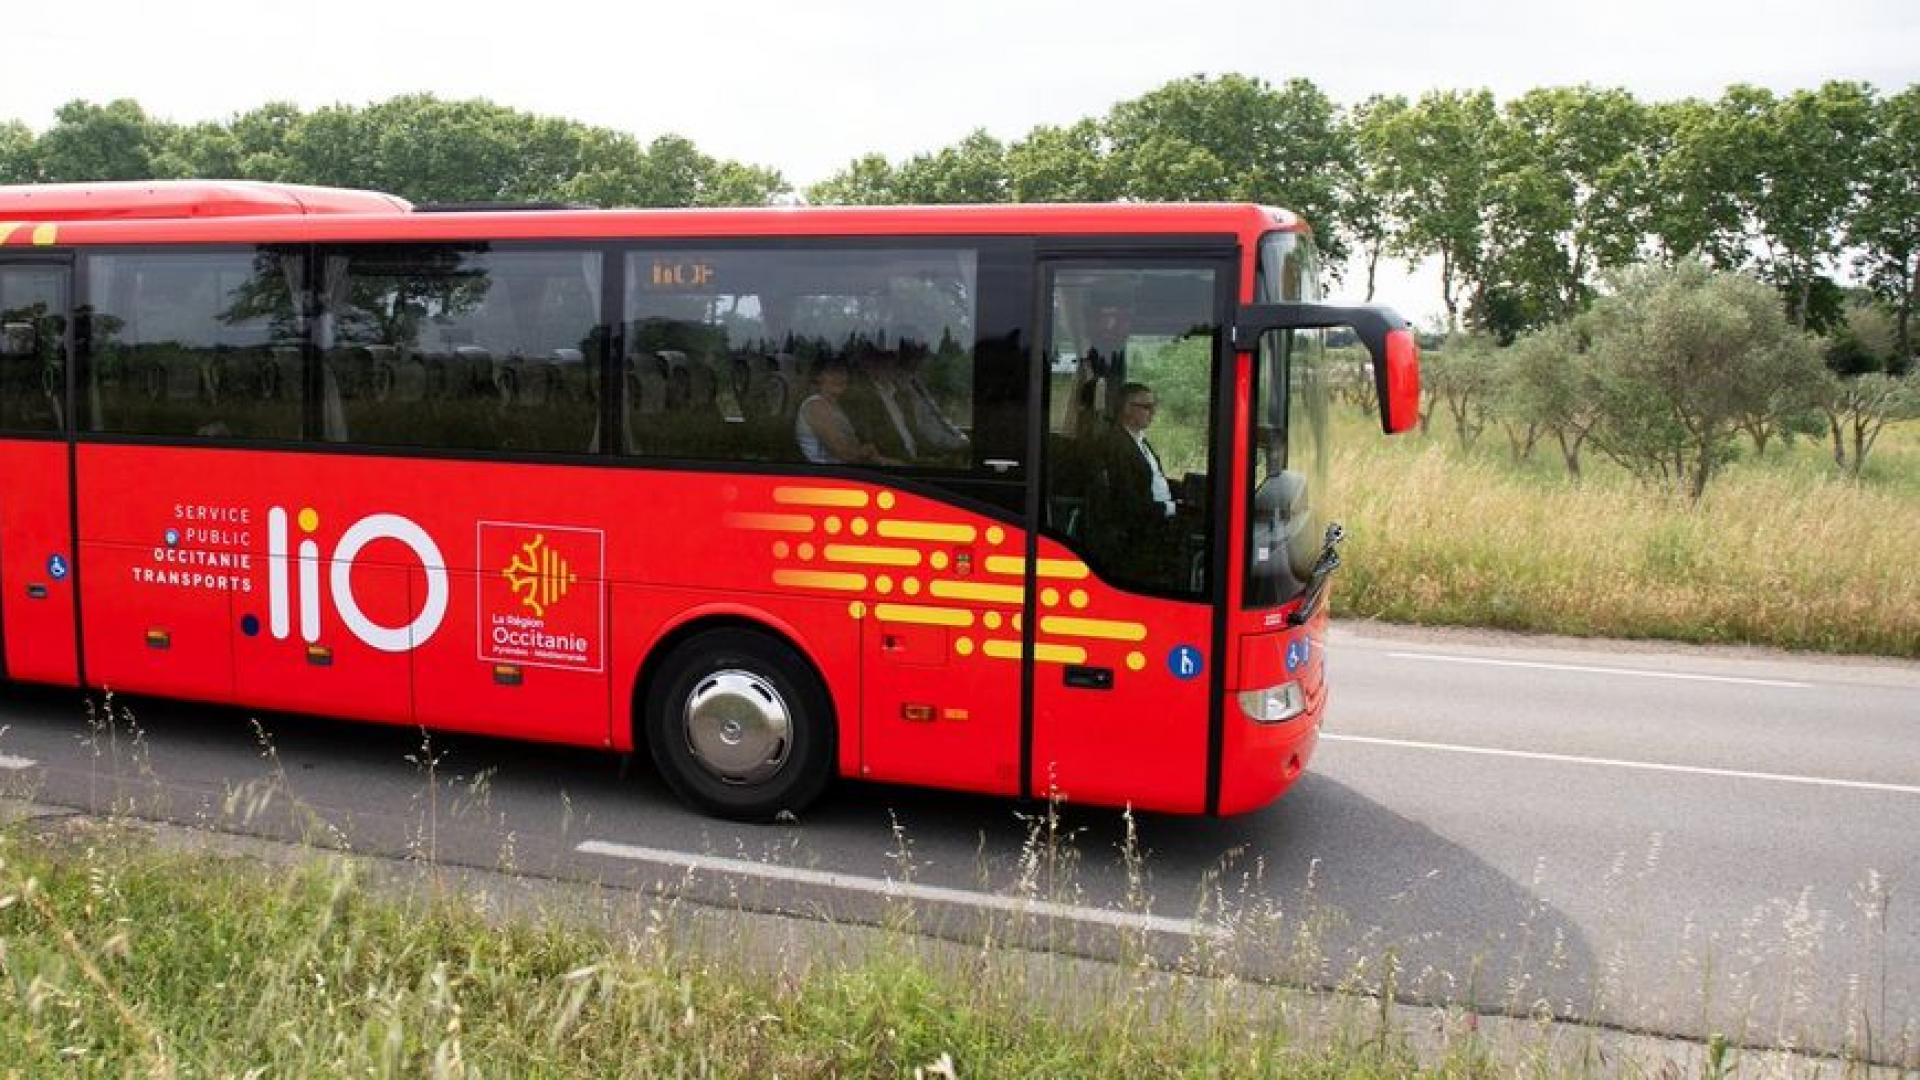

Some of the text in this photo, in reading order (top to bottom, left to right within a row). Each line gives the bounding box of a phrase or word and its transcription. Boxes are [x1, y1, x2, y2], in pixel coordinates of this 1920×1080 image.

[174, 503, 250, 523] SERVICE
[186, 527, 250, 546] PUBLIC
[154, 547, 251, 569] OCCITANIE
[132, 567, 252, 593] TRANSPORTS
[492, 613, 505, 624] La
[492, 626, 588, 652] Occitanie
